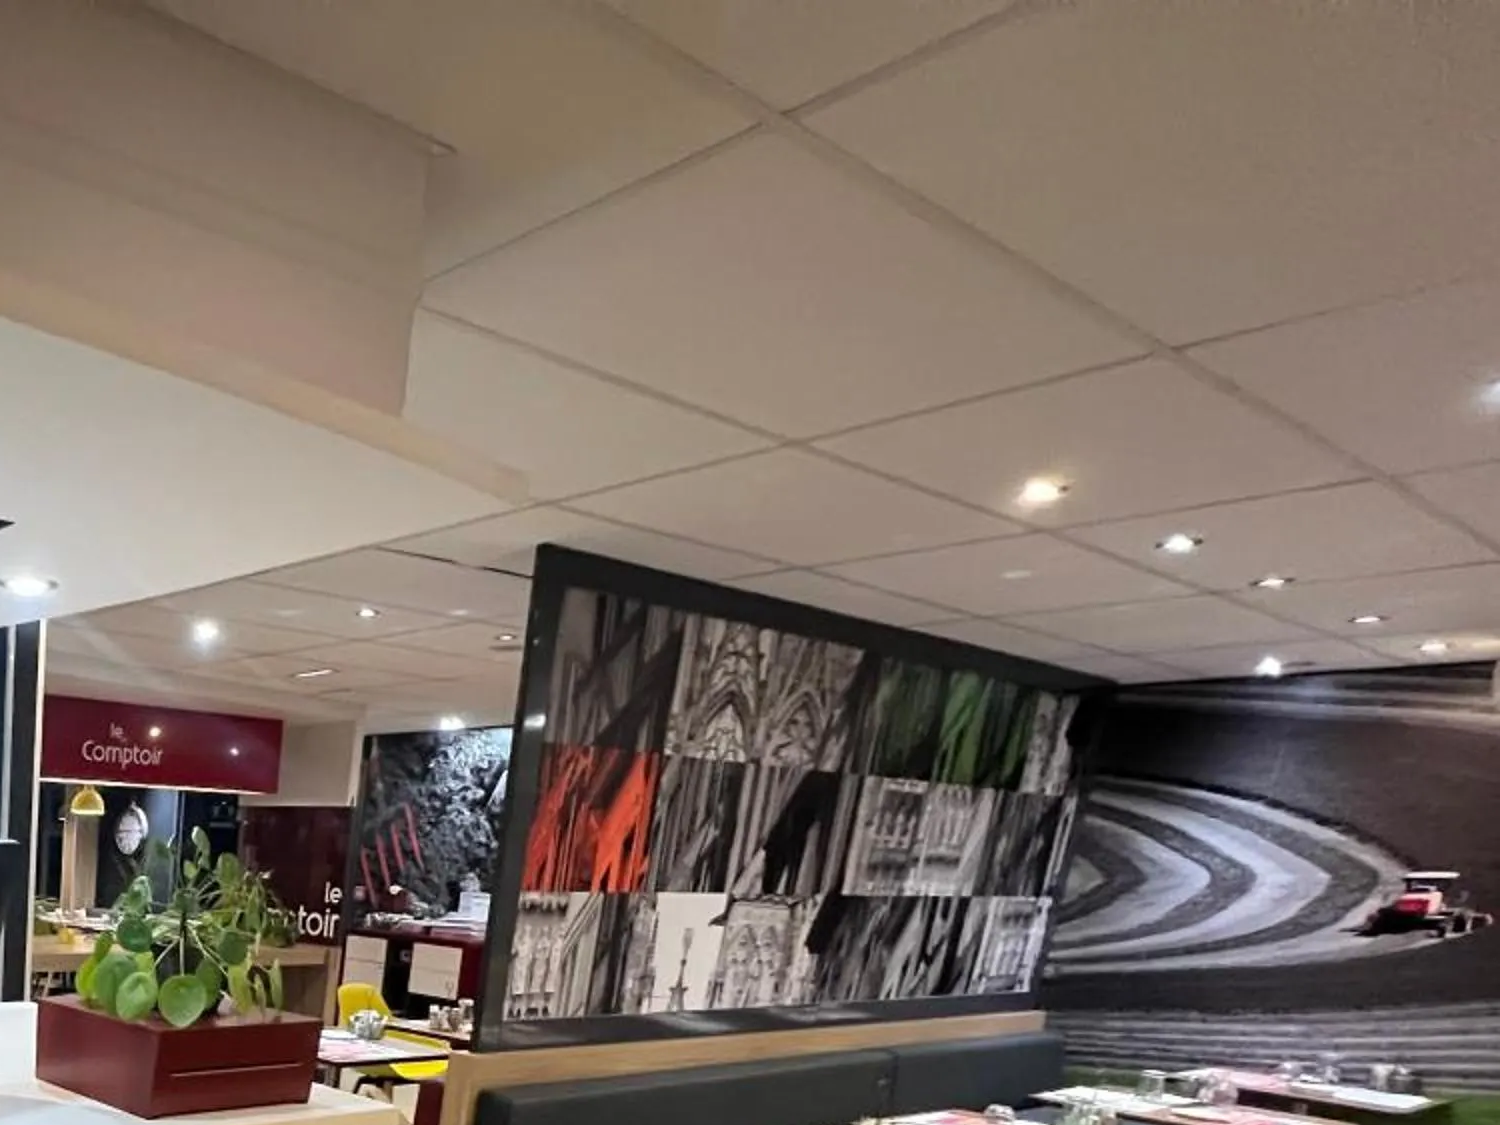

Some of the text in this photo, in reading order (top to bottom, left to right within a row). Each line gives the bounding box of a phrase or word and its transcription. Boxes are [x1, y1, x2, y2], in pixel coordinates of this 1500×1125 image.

[110, 722, 124, 738] le
[81, 739, 163, 770] Comptoir
[324, 881, 343, 904] le
